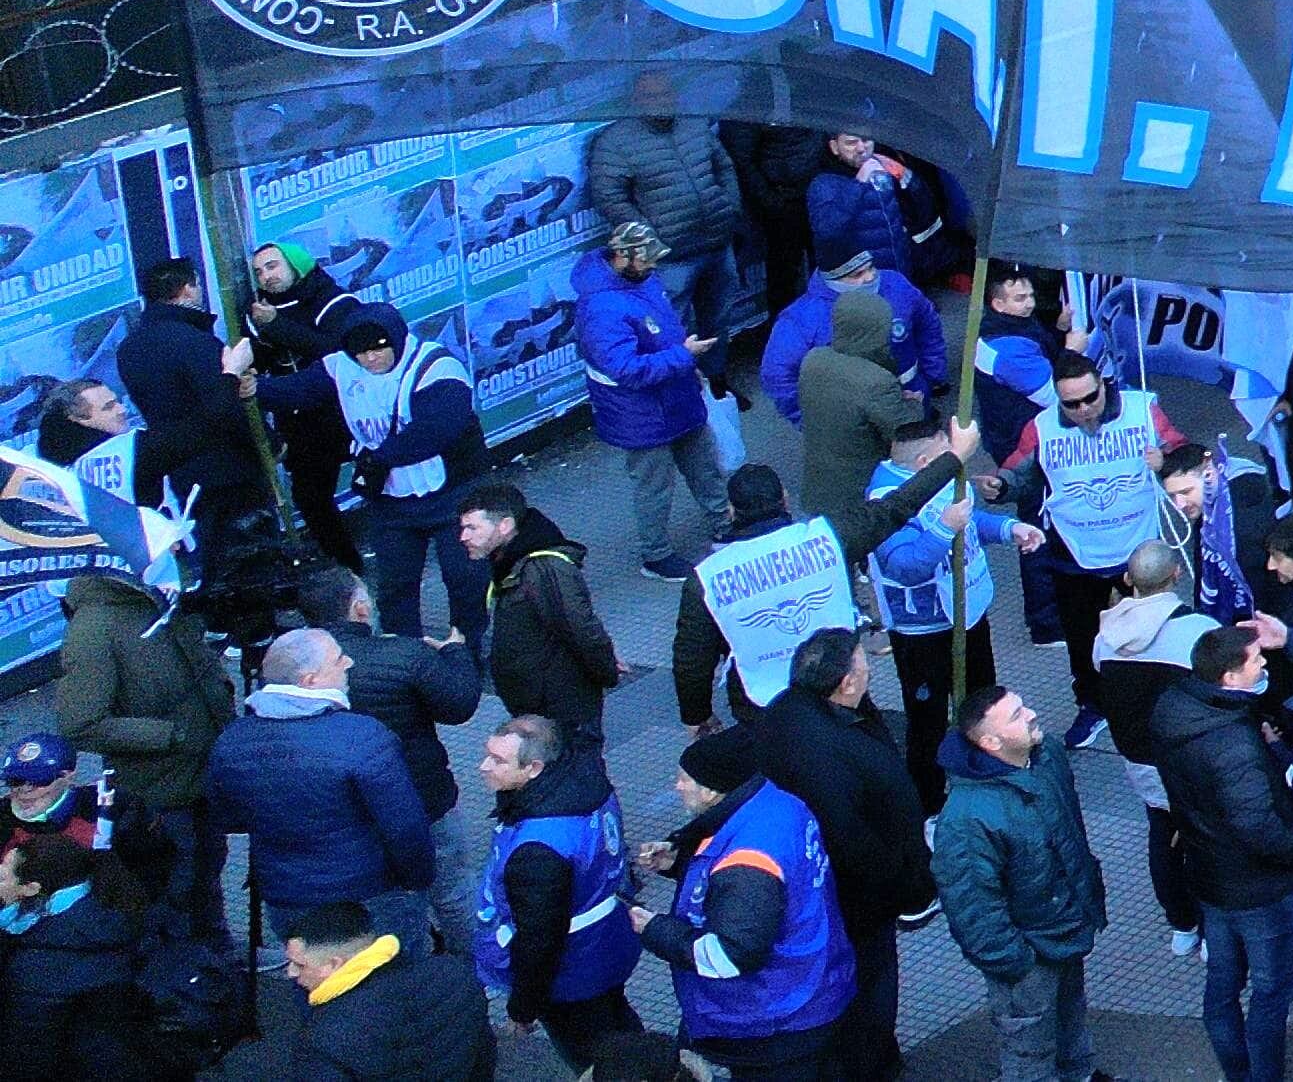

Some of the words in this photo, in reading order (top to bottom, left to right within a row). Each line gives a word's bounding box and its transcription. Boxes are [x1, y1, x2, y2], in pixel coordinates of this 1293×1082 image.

[357, 12, 424, 41] R.A.
[255, 151, 368, 208] CONSTRUIR
[33, 243, 124, 293] UNIDAD
[467, 218, 567, 274] CONSTRUIR
[477, 342, 577, 401] CONSTRUIR
[1044, 426, 1148, 469] AERONAVEGANTES
[711, 535, 837, 607] AERONAVEGANTES
